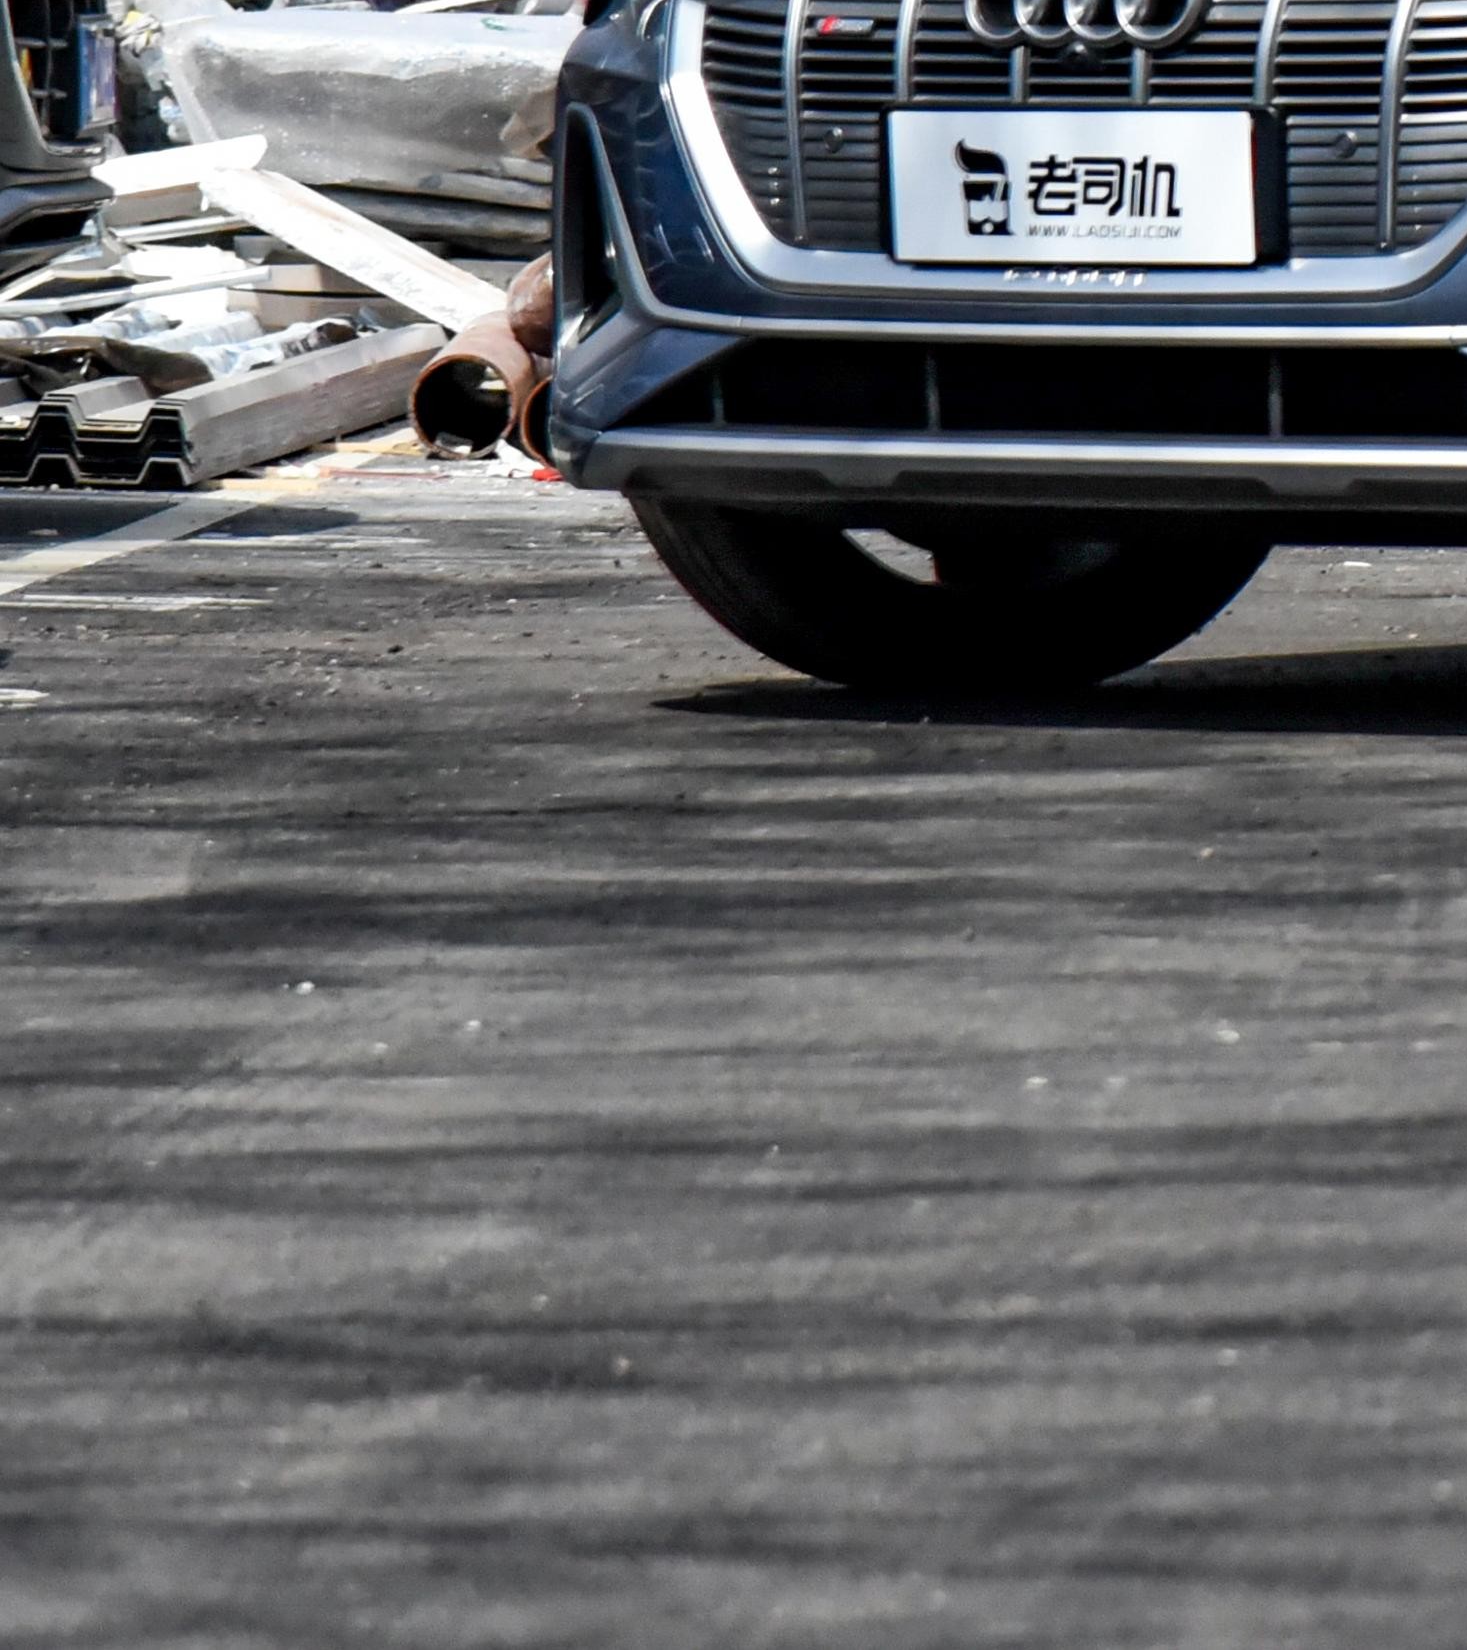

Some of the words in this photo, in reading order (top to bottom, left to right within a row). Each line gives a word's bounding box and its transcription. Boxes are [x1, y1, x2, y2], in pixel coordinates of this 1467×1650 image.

[1027, 154, 1181, 217] 老司机
[1026, 225, 1182, 238] WWW.LAOSIJI.COM
